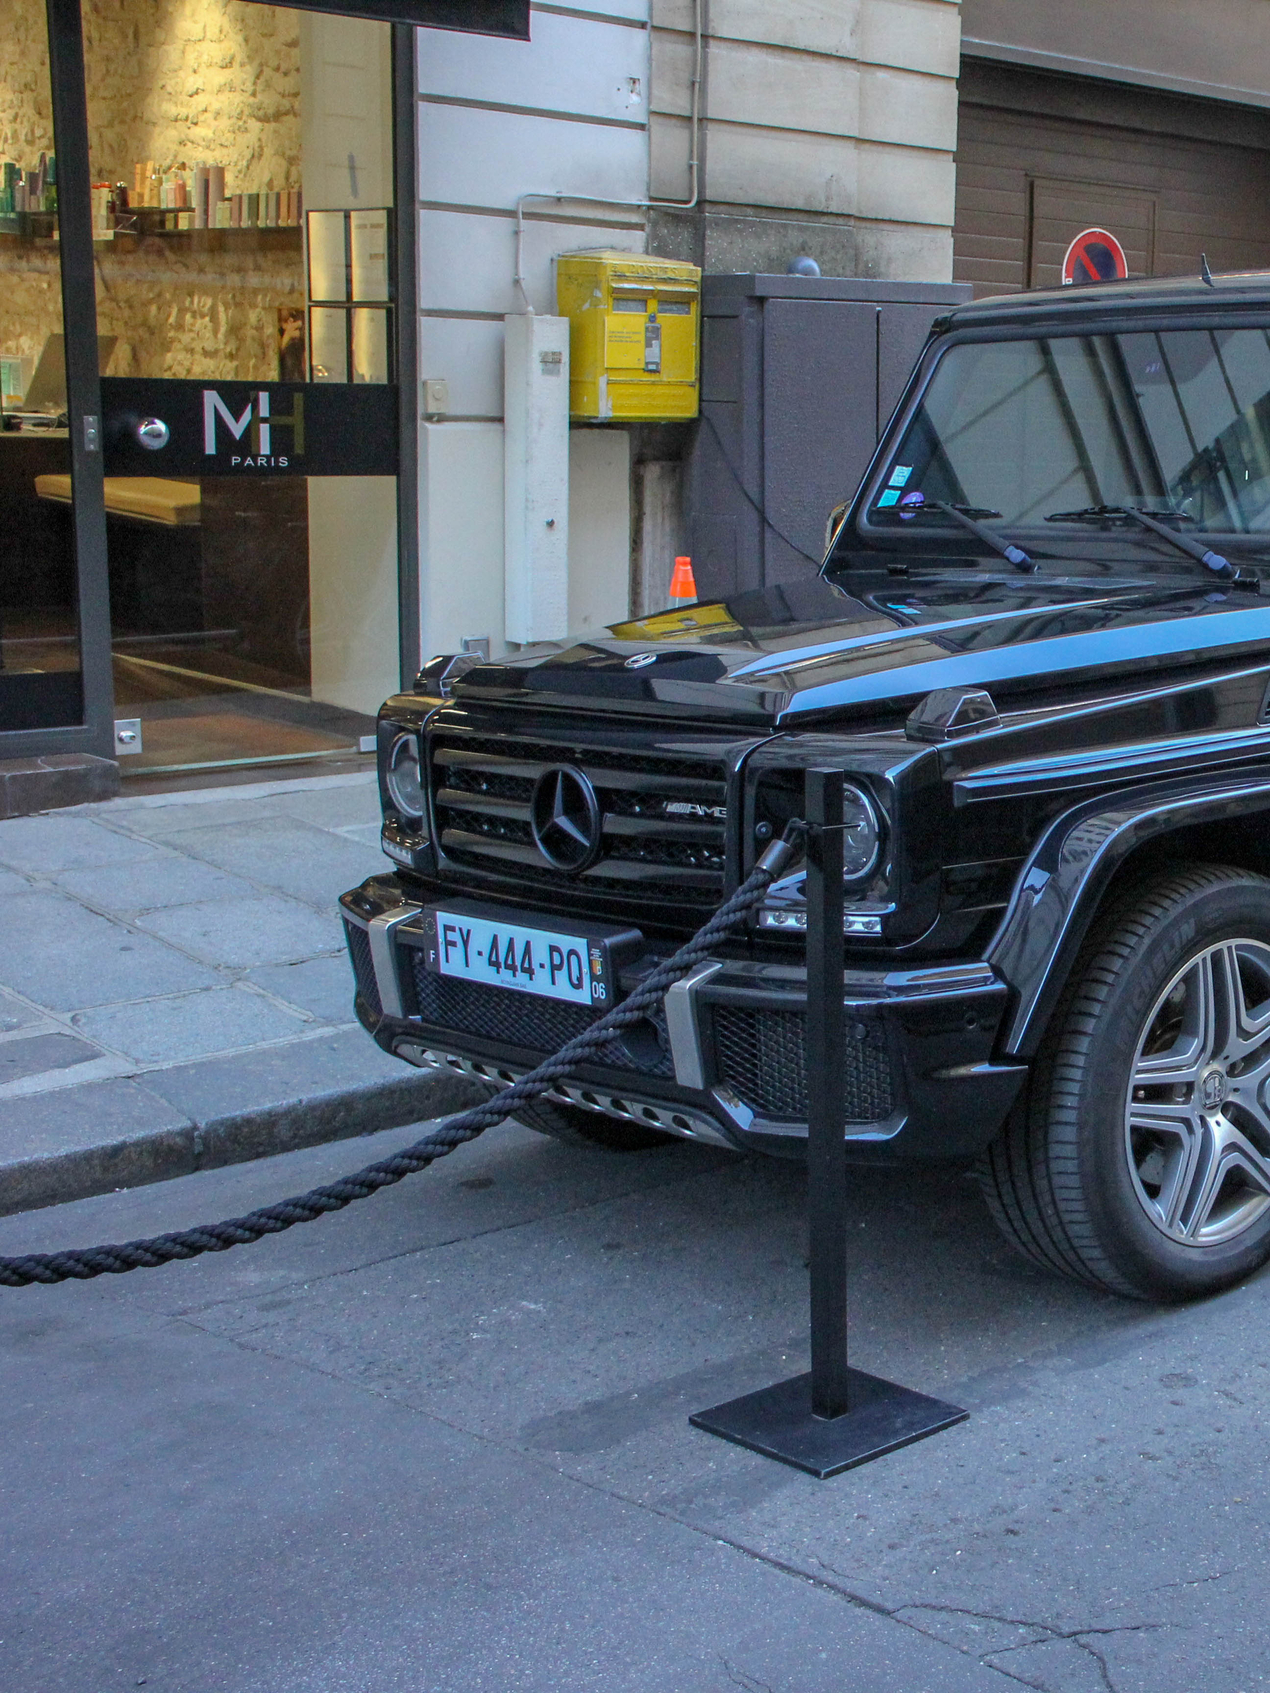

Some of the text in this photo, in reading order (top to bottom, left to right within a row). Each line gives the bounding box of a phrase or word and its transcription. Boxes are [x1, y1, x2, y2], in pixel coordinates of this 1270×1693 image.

[231, 456, 290, 468] PARIS
[443, 923, 584, 991] FY-444-PQ
[592, 981, 606, 1000] 06
